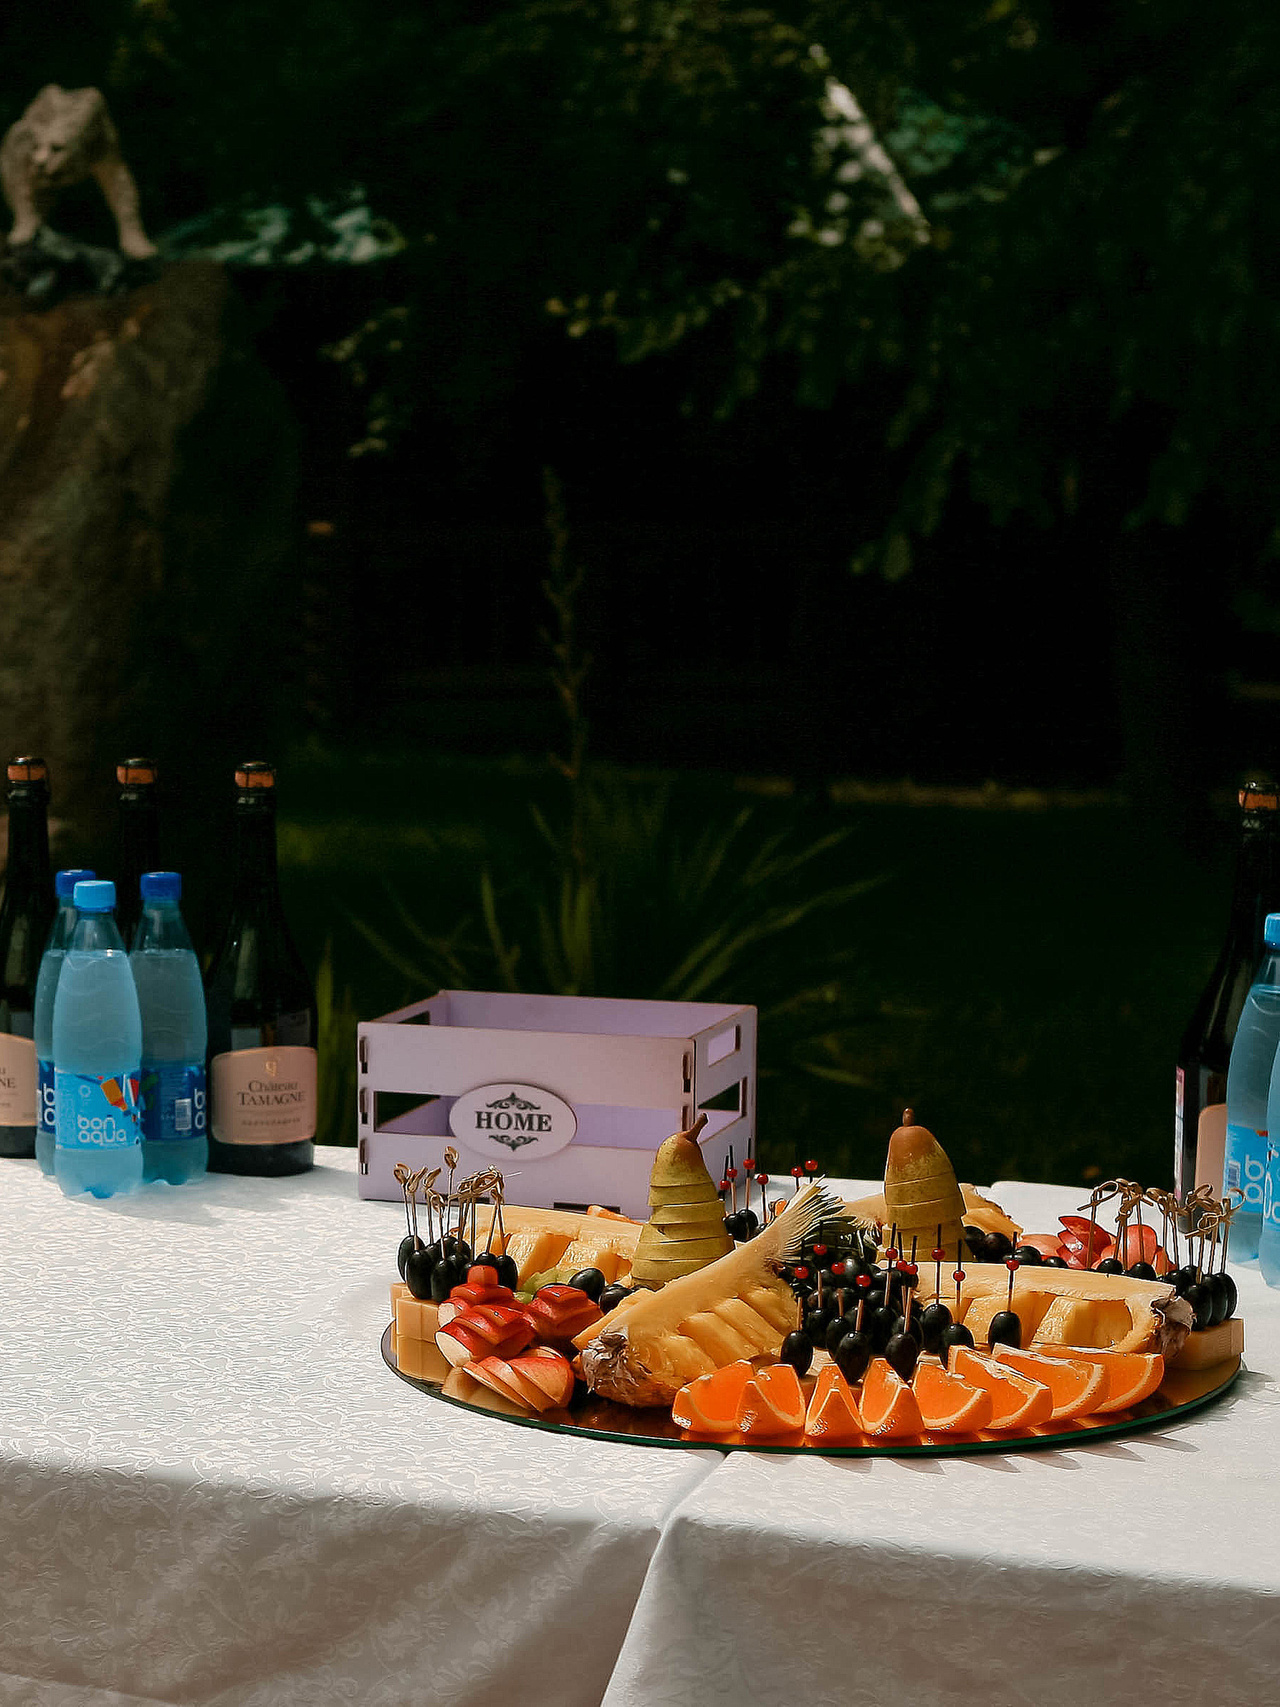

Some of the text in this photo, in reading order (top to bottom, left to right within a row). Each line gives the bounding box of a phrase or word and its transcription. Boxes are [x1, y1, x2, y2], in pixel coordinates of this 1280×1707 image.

[237, 1090, 306, 1106] TAMAGNE
[77, 1115, 115, 1130] bon
[474, 1111, 552, 1132] HOME
[78, 1129, 127, 1144] aqua
